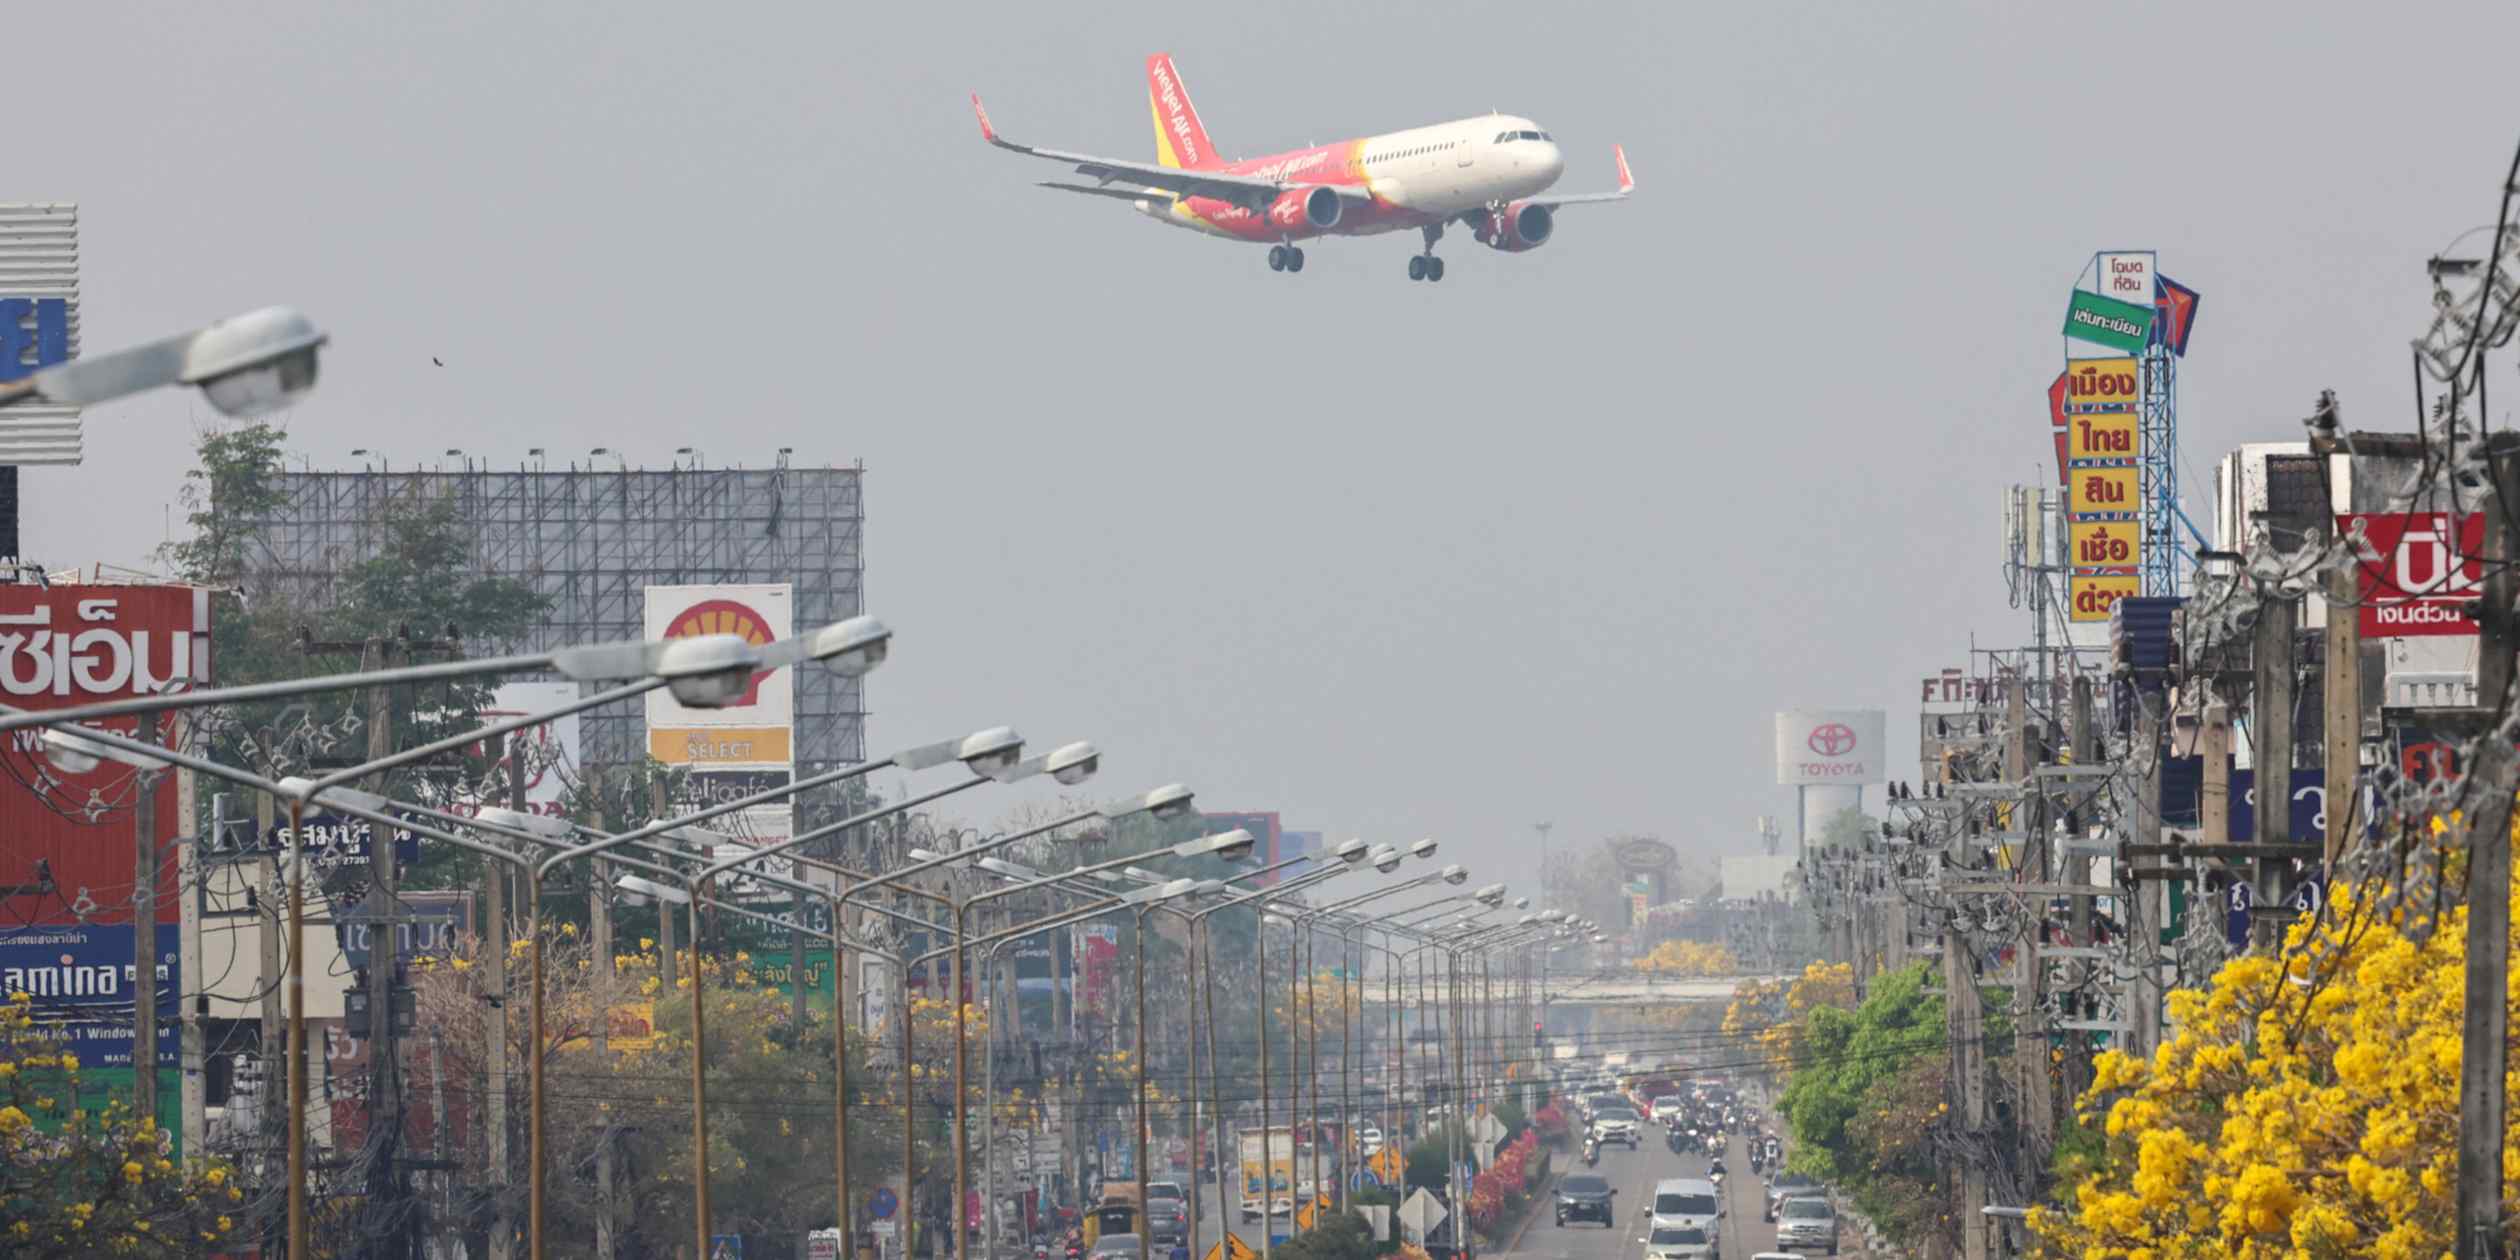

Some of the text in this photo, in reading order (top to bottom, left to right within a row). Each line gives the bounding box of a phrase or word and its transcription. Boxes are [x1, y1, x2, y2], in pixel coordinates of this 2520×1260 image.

[2073, 307, 2143, 337] เล่มทะเบียน
[2070, 366, 2136, 396] เมือง
[2077, 419, 2131, 452] ไทย
[2085, 476, 2125, 503] สิน
[2080, 525, 2129, 562] เชื่อ
[2076, 582, 2134, 613] ด่ว
[687, 742, 753, 759] SELECT
[1798, 762, 1864, 777] TOYOTA
[0, 953, 118, 997] amina
[87, 1027, 136, 1040] Window
